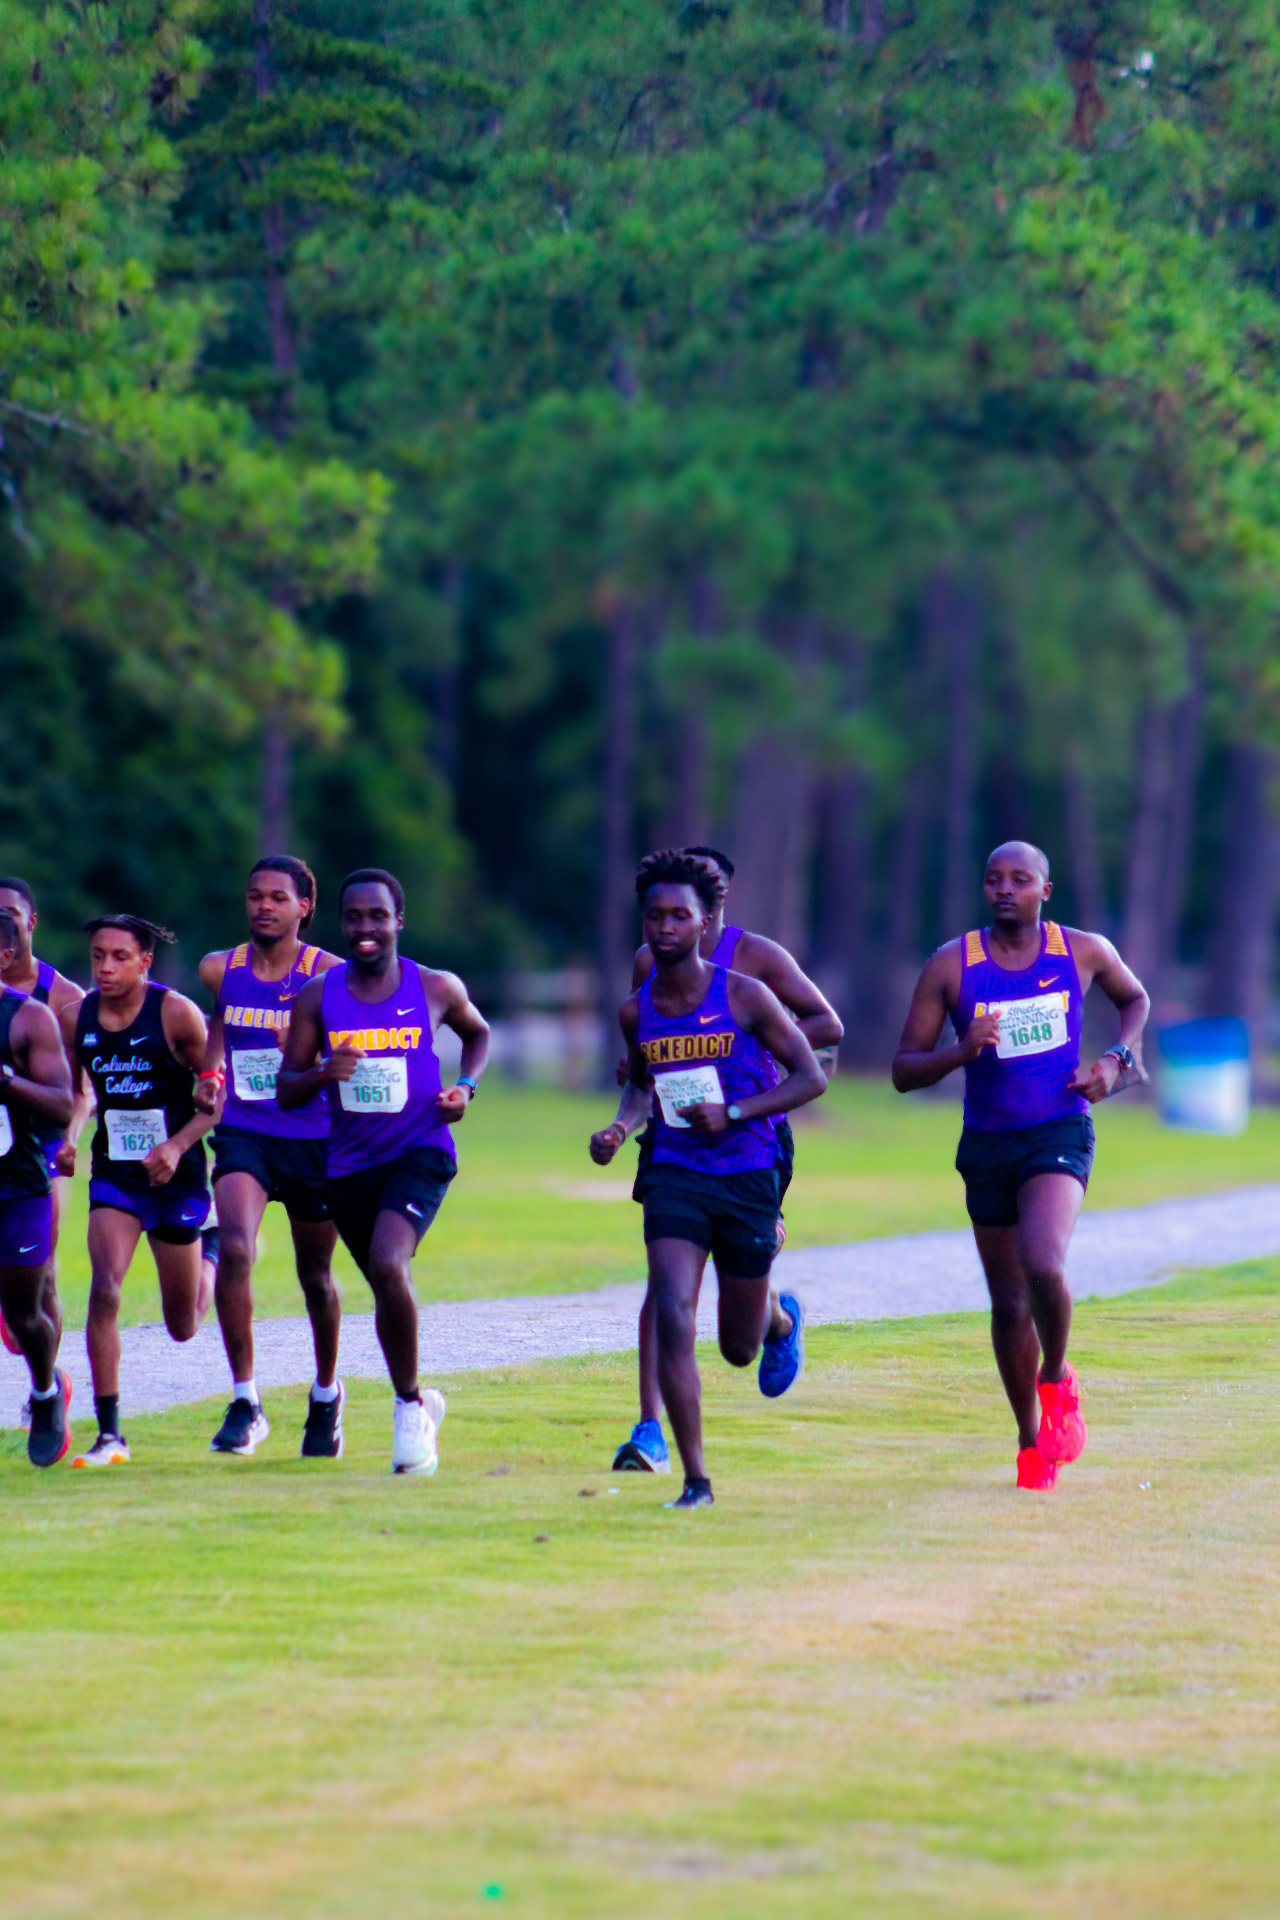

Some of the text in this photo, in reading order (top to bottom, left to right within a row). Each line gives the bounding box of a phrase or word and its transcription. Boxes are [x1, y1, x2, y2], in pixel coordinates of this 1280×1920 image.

[1008, 1022, 1053, 1047] 1648
[92, 1054, 153, 1073] Columbia
[105, 1075, 153, 1099] College
[353, 1085, 391, 1103] 1651
[121, 1134, 156, 1152] 1623
